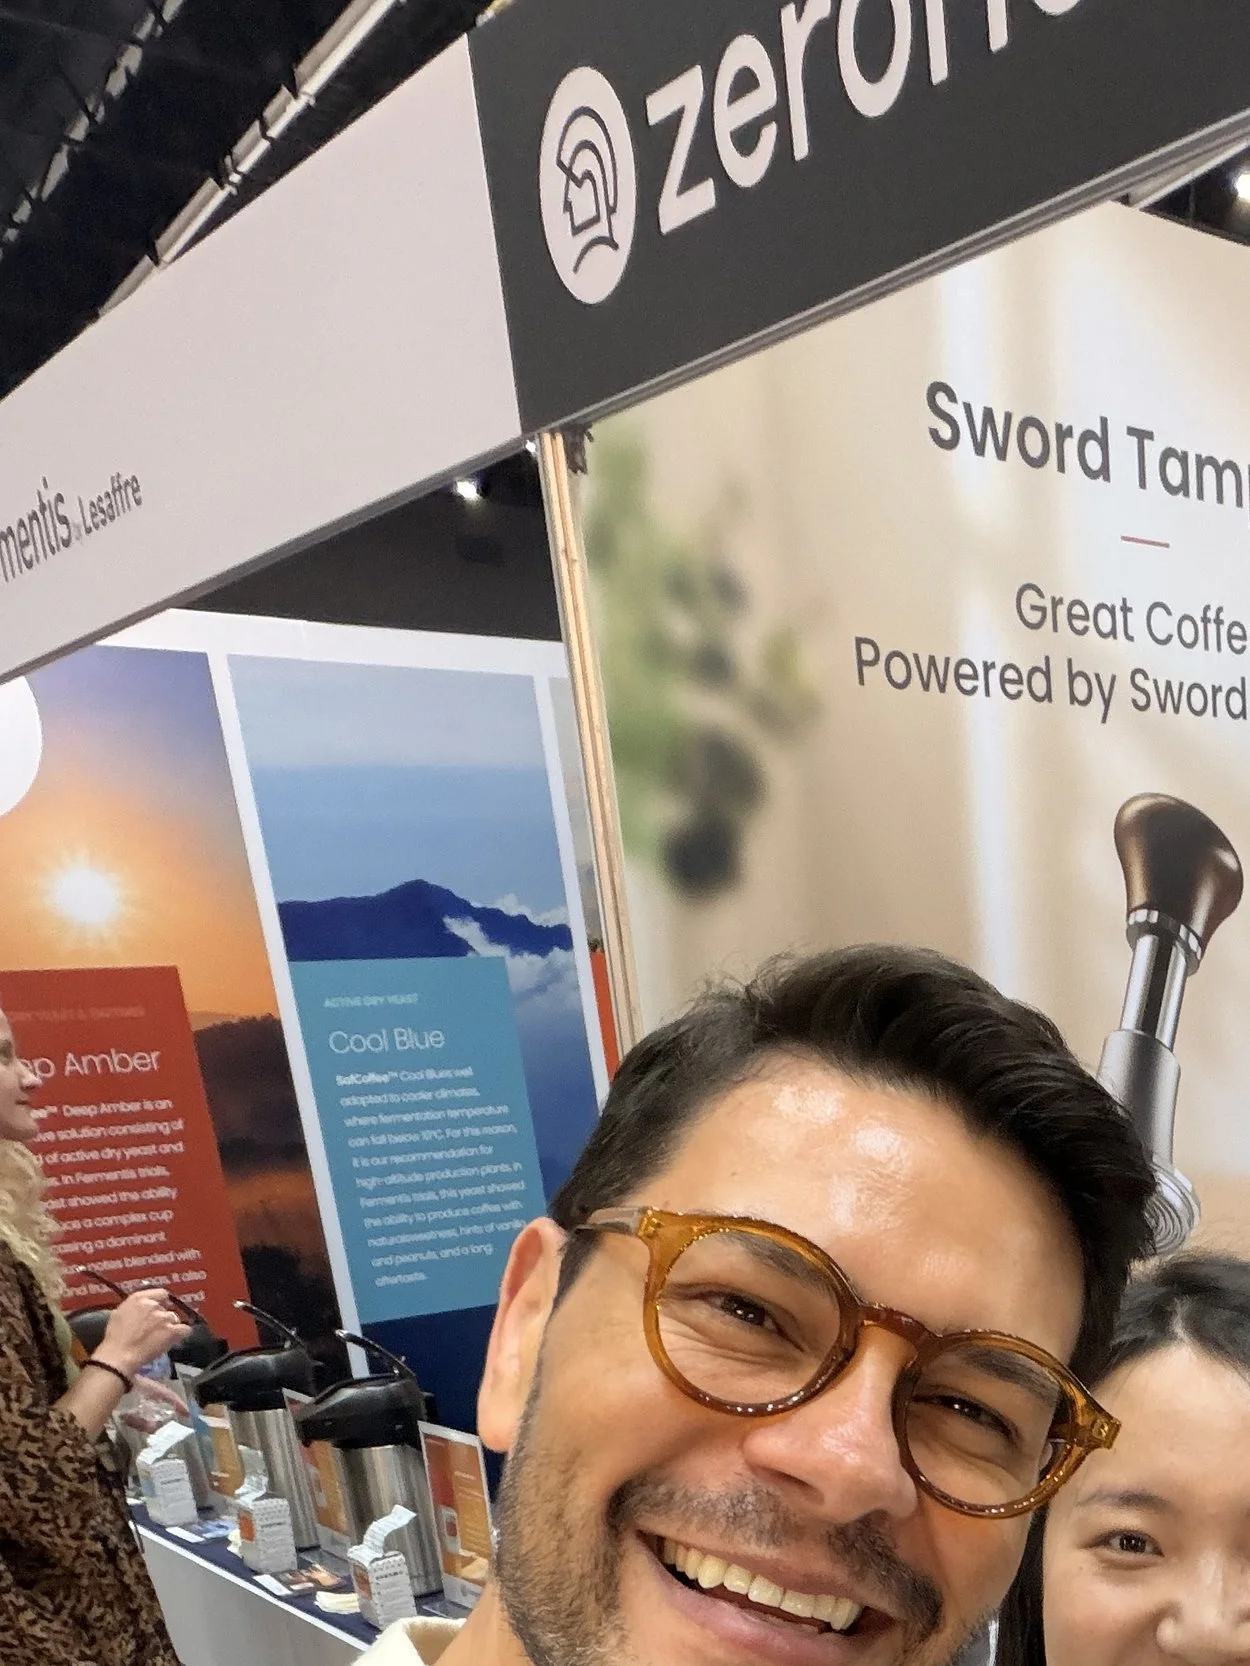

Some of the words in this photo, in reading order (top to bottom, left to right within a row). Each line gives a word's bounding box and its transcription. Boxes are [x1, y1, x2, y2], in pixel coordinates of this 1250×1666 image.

[925, 380, 1111, 484] Sword
[78, 471, 142, 534] Lesaffre
[1015, 582, 1135, 643] Great
[854, 636, 1053, 704] Powered
[1067, 657, 1116, 725] by
[1131, 667, 1248, 722] Sword
[64, 1046, 161, 1075] Amber
[328, 1029, 388, 1053] Cool
[394, 1026, 445, 1049] Blue
